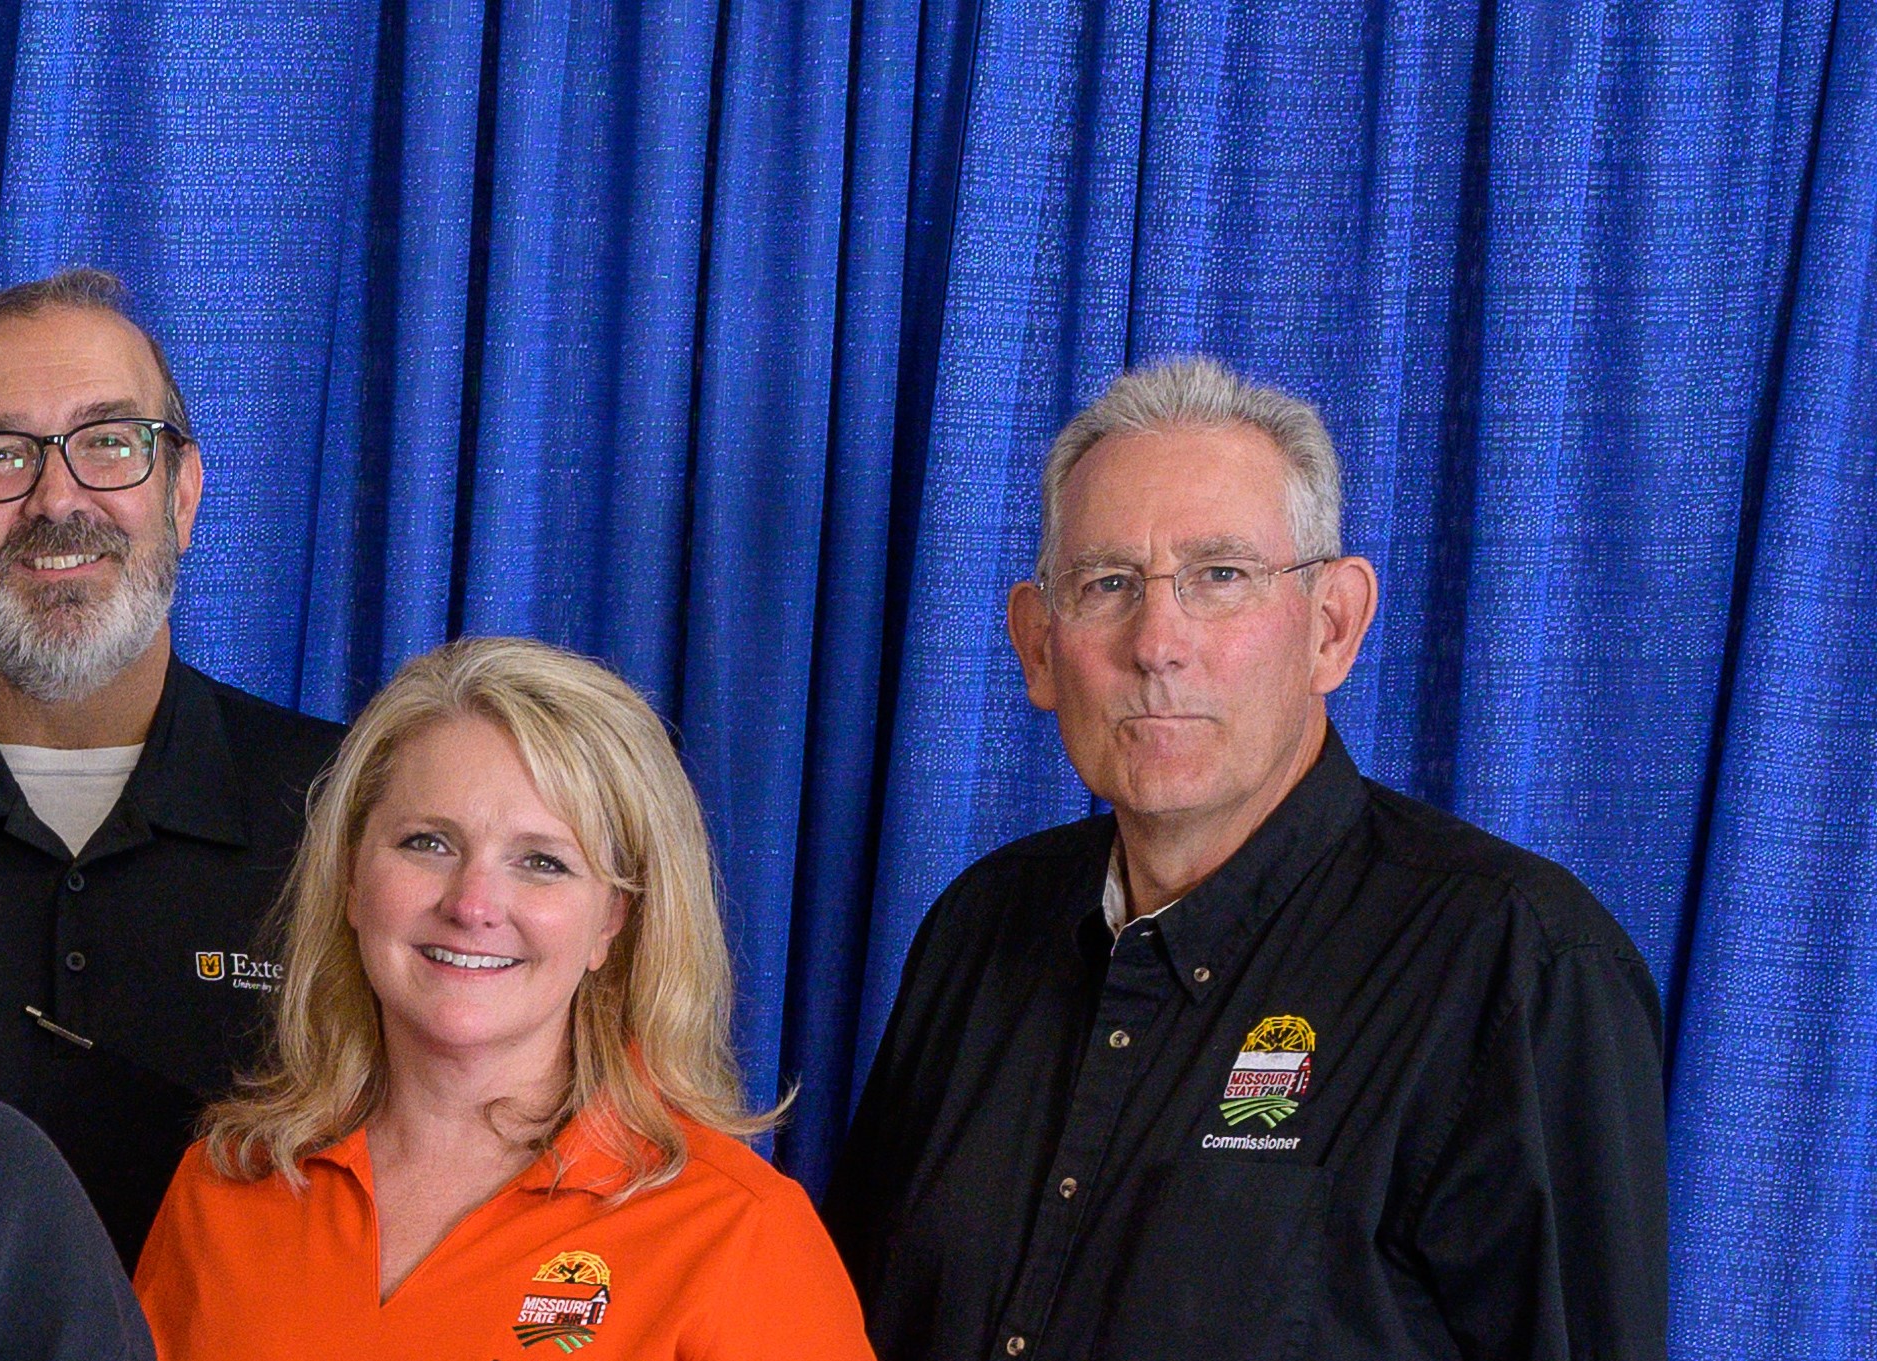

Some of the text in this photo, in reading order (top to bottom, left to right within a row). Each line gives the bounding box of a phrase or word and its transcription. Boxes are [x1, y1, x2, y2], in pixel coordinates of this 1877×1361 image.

[1230, 1072, 1292, 1085] MISSOURI
[1226, 1086, 1287, 1096] STATE FAIR
[1201, 1134, 1301, 1150] Commissioner
[523, 1296, 588, 1314] MISSOURI
[518, 1311, 556, 1323] STATE
